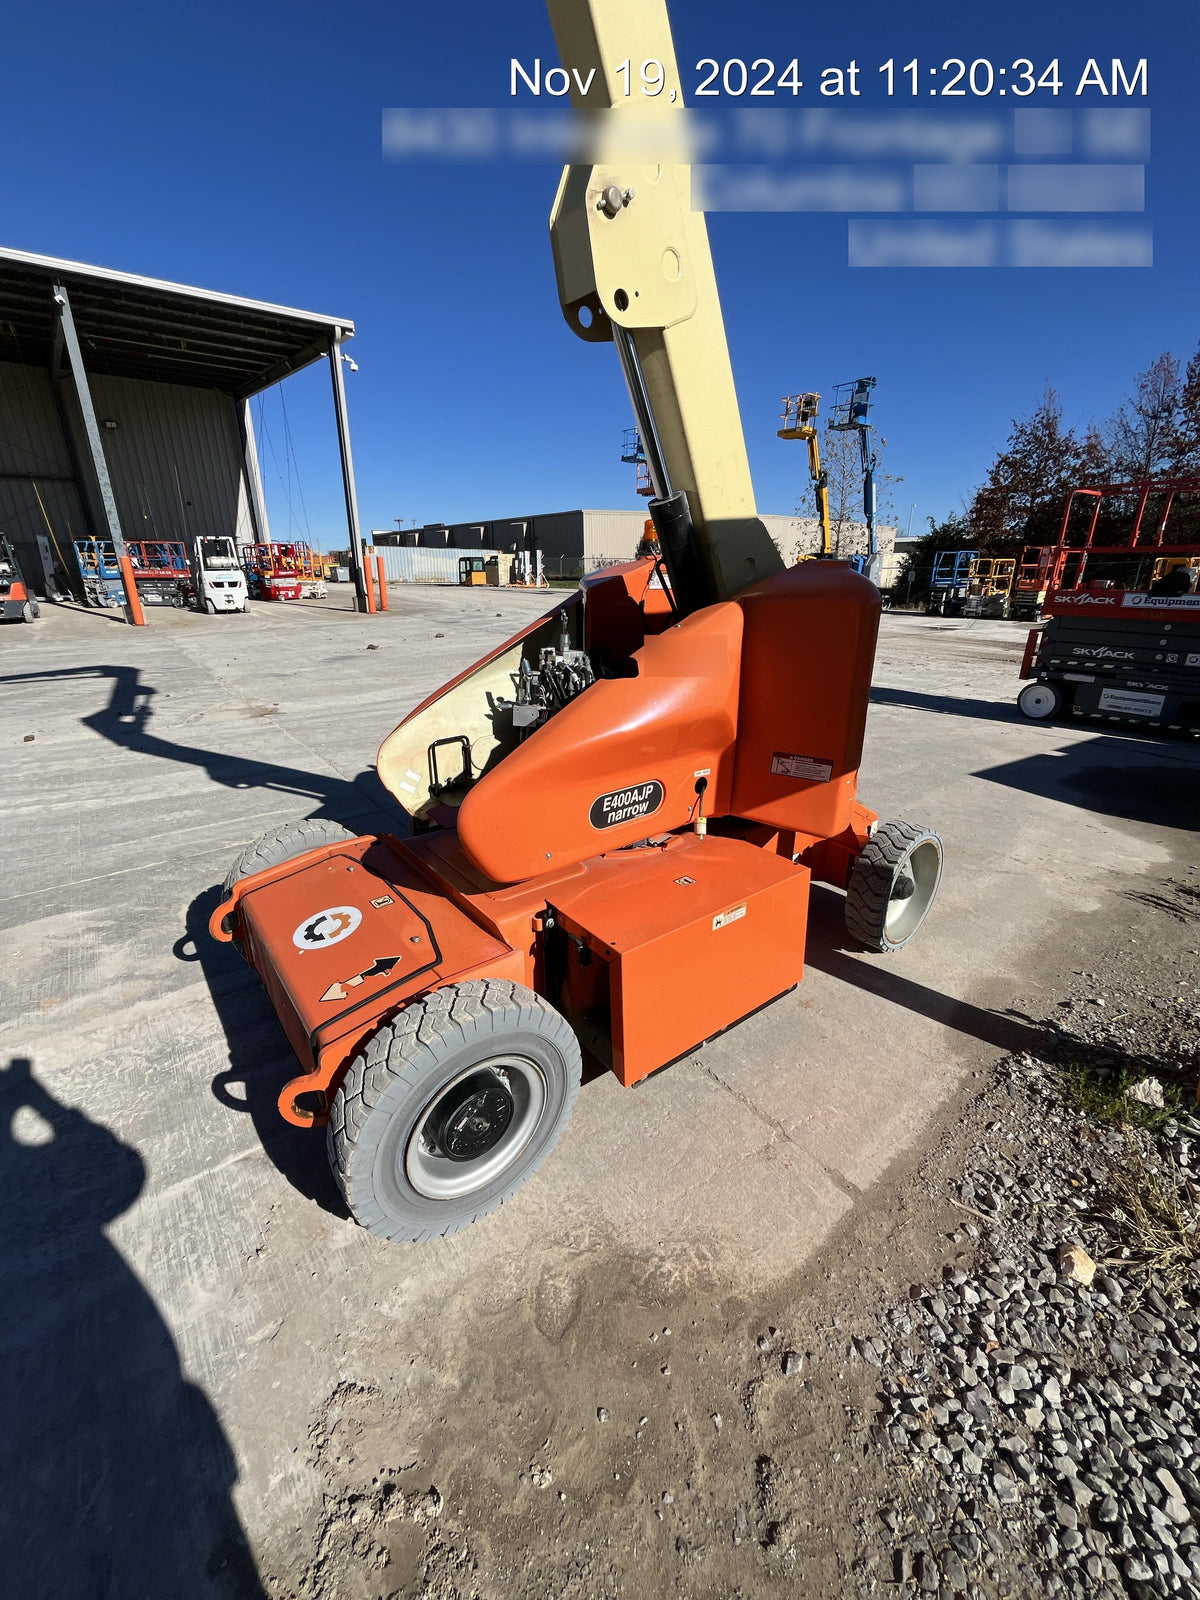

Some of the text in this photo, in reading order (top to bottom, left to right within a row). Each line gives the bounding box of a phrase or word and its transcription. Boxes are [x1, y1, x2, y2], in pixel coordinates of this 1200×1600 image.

[1054, 593, 1115, 605] SKYJACK
[1073, 646, 1135, 660] SKYJACK
[602, 785, 654, 812] E400AJP
[607, 801, 650, 823] narrow
